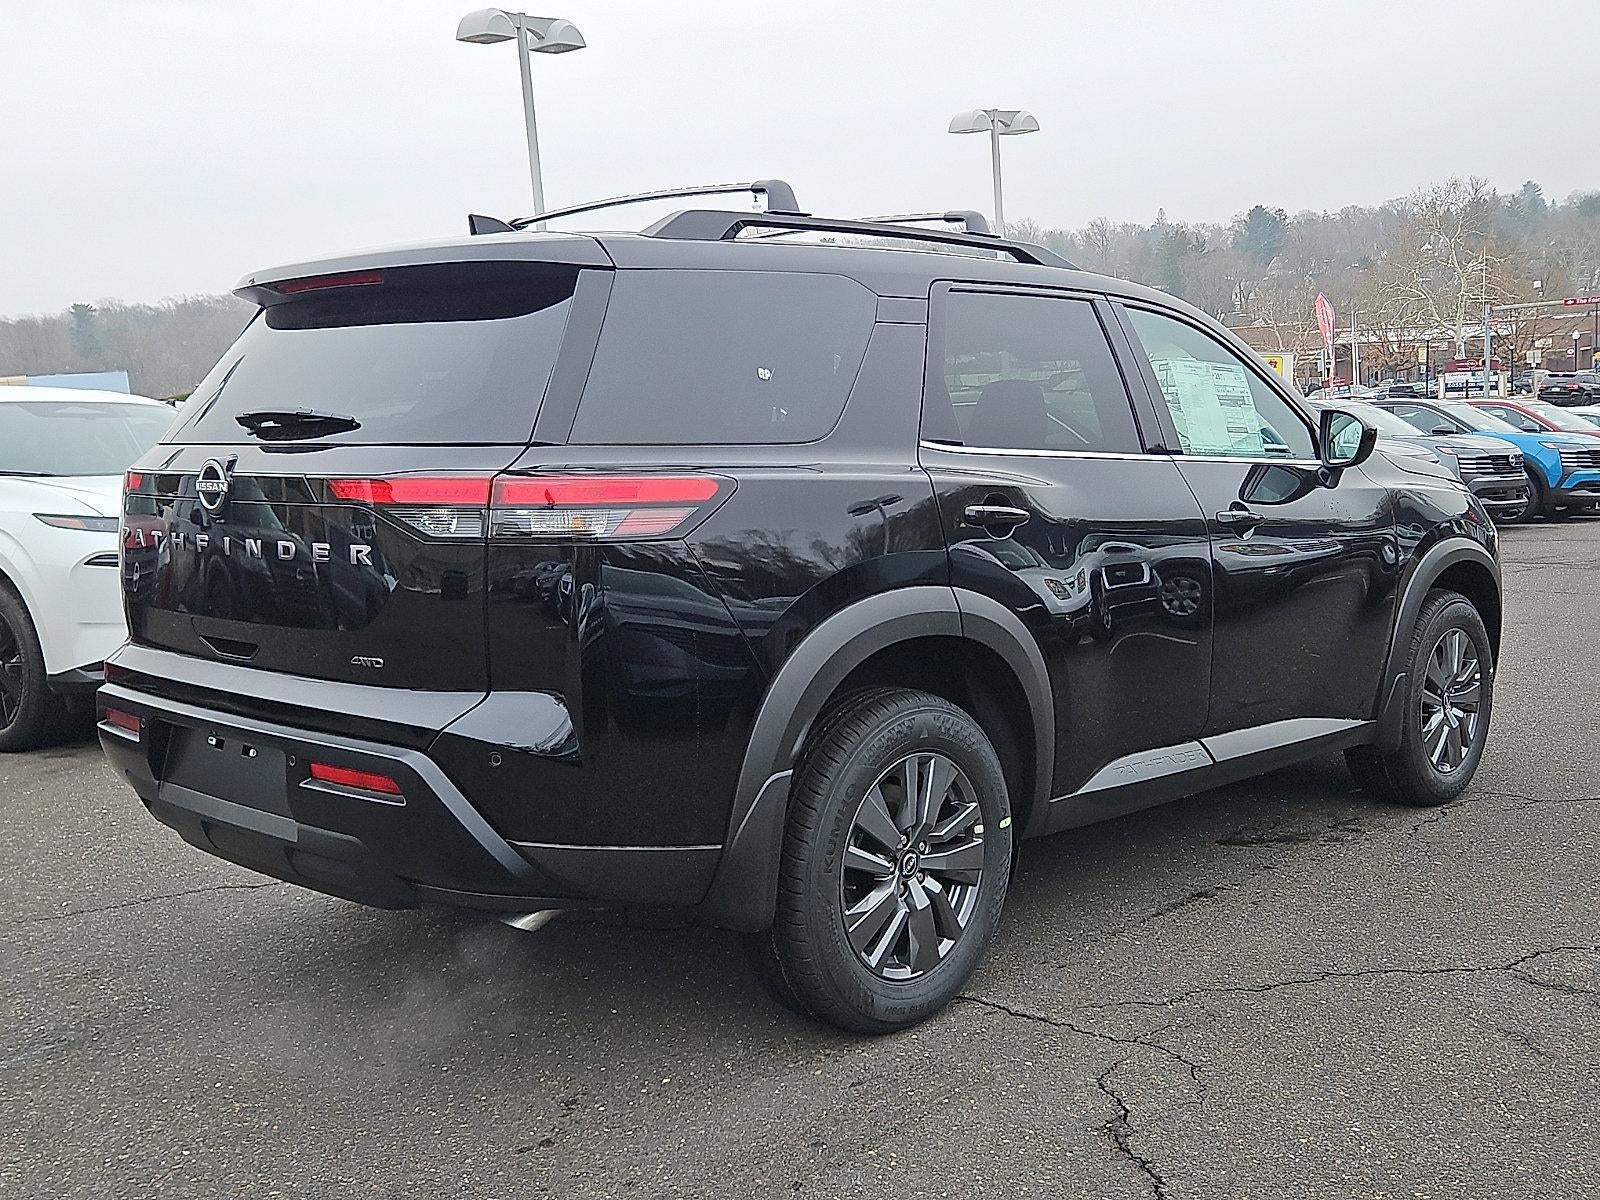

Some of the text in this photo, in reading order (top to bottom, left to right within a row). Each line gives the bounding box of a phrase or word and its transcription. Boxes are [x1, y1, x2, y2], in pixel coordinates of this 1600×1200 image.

[121, 526, 373, 567] PATHFINDER
[350, 655, 384, 668] 4WD
[1112, 748, 1207, 776] PATHFINDER
[823, 783, 857, 874] KUMHO
